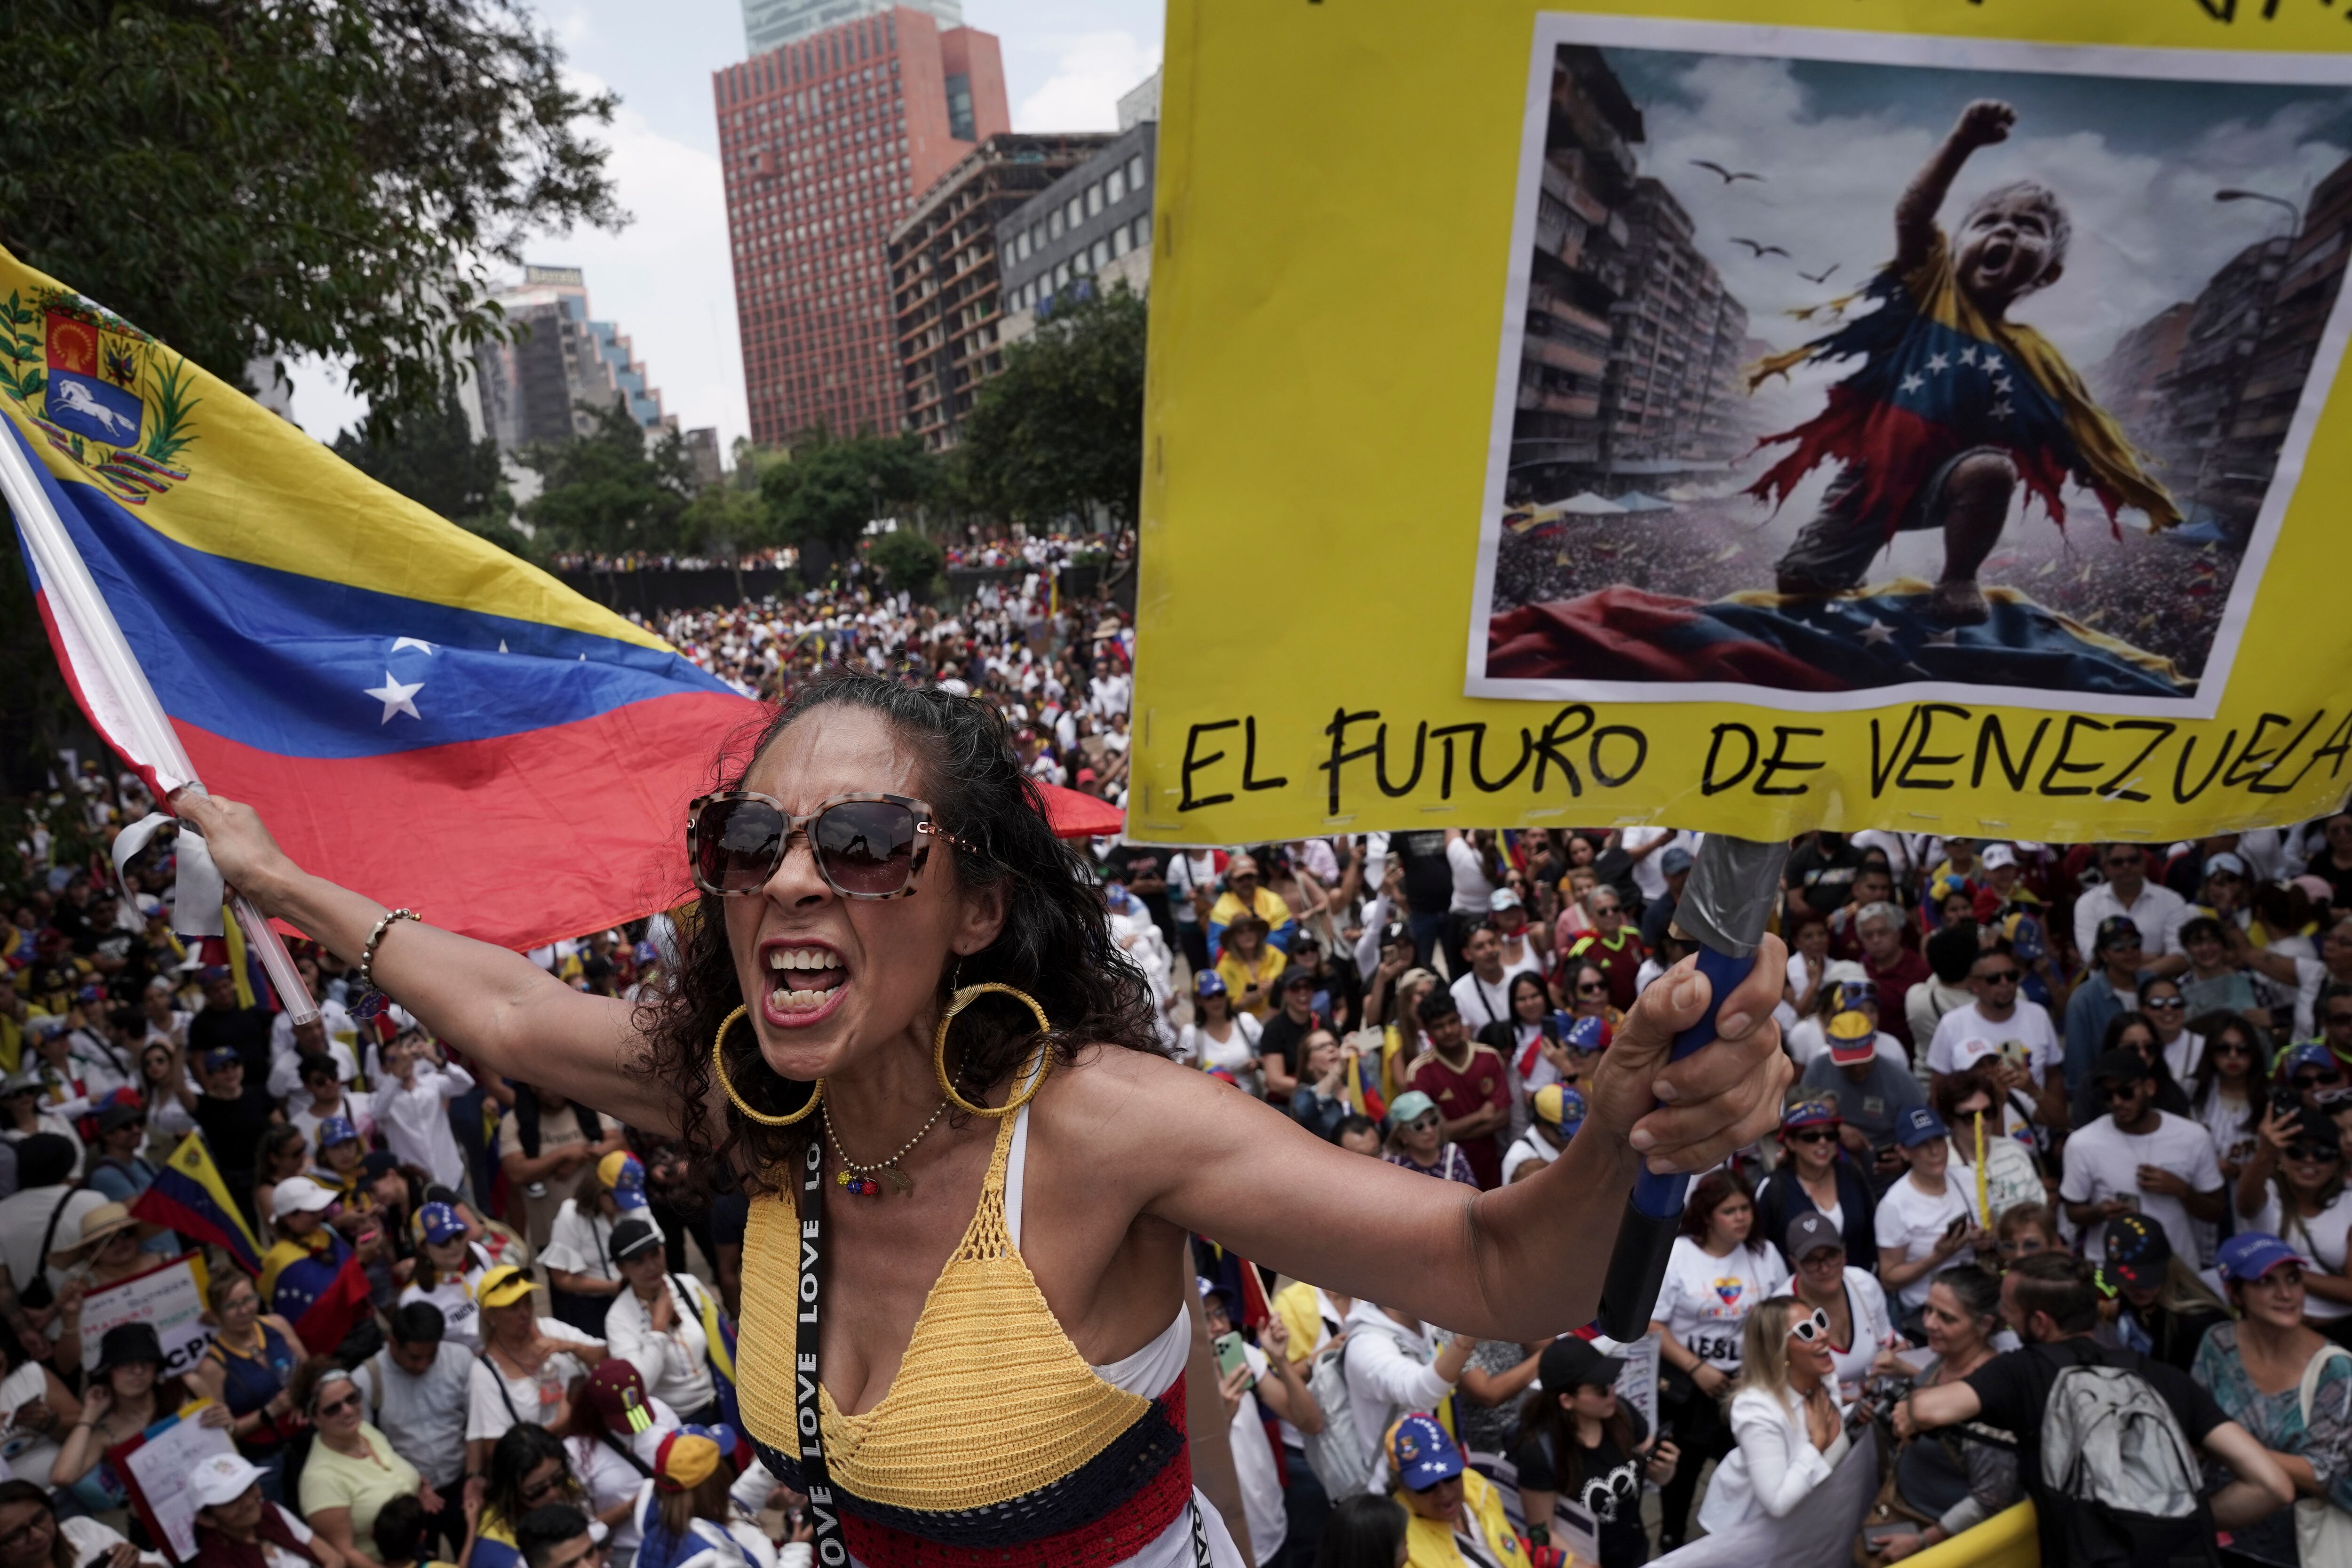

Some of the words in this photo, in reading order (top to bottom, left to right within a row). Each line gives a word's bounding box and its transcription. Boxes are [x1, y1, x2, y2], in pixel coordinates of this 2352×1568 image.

[1177, 716, 1287, 813] EL
[1319, 704, 1647, 816] FUTURO
[1700, 722, 1826, 797] DE
[1870, 704, 2352, 804] VENEZUELA
[805, 1142, 820, 1191] LO
[799, 1220, 819, 1323] LOVE
[798, 1353, 821, 1457] LOVE
[809, 1486, 846, 1566] OVE
